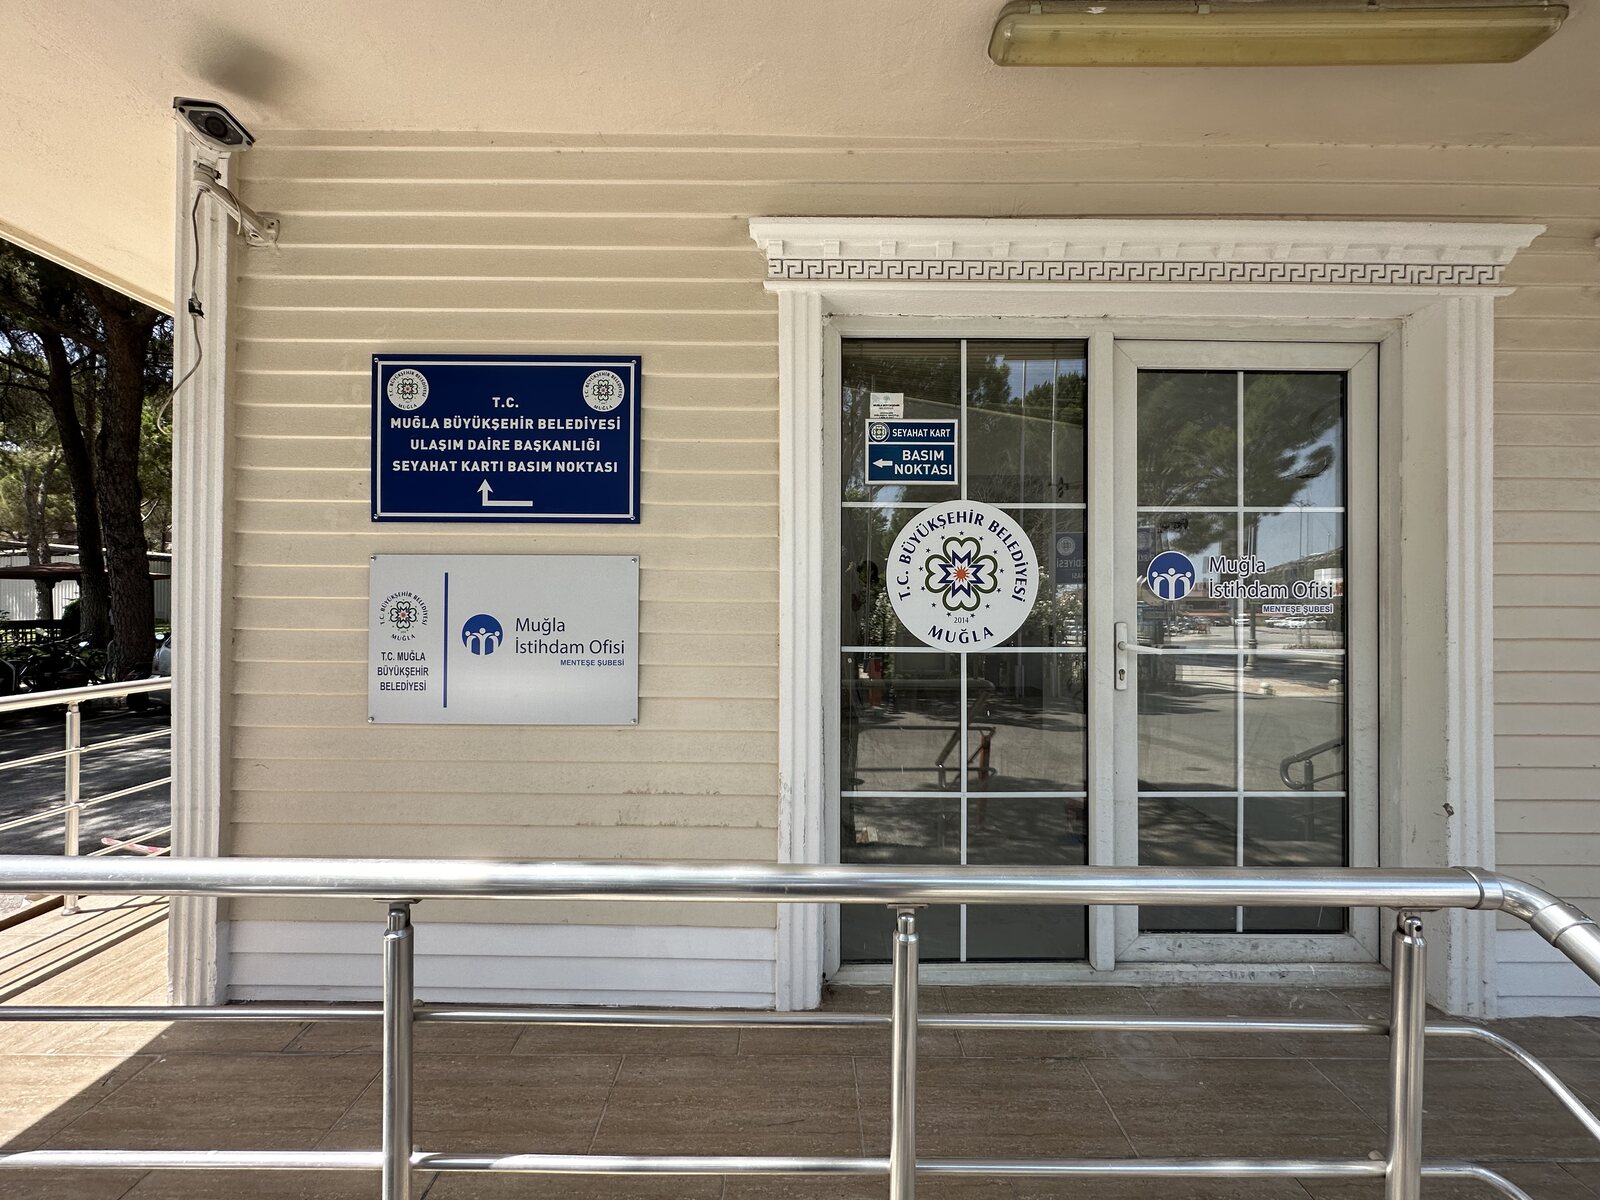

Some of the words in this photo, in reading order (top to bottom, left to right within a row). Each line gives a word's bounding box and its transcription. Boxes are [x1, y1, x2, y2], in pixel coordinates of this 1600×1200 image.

[492, 397, 519, 408] T.C.
[390, 415, 439, 429] MUĞLA
[443, 415, 534, 431] BÜYÜKŞEHİR
[537, 416, 621, 430] BELEDİYESİ
[892, 428, 928, 438] SEYAHAT
[930, 428, 951, 438] KART
[410, 439, 464, 452] ULAŞIM
[467, 437, 510, 451] DAİRE
[514, 437, 600, 453] BAŞKANLIĞI
[902, 449, 944, 461] BASIM
[392, 460, 457, 472] SEYAHAT
[461, 460, 503, 472] KARTI
[507, 461, 552, 473] BASIM
[556, 461, 618, 473] NOKTASI
[894, 463, 952, 476] NOKTASI
[899, 509, 985, 565] BÜYÜKŞEHİR
[987, 519, 1029, 603] BELEDİYESİ
[1209, 556, 1266, 576] Muğla
[897, 570, 911, 601] T.C.
[1209, 579, 1288, 599] İstihdam
[1292, 581, 1333, 598] Ofisi
[1263, 605, 1301, 614] MENTEŞE
[1303, 604, 1333, 614] ŞUBESİ
[515, 617, 566, 636] Muğla
[953, 616, 969, 624] 2014
[927, 625, 994, 644] MUĞLA
[515, 638, 584, 655] İstihdam
[589, 639, 625, 655] Ofisi
[381, 652, 395, 661] T.C.
[397, 650, 426, 662] MUĞLA
[560, 659, 596, 668] MENTEŞE
[597, 658, 625, 668] ŞUBESİ
[377, 664, 429, 679] BÜYÜKŞEHİR
[380, 679, 427, 691] BELEDİYESİ
